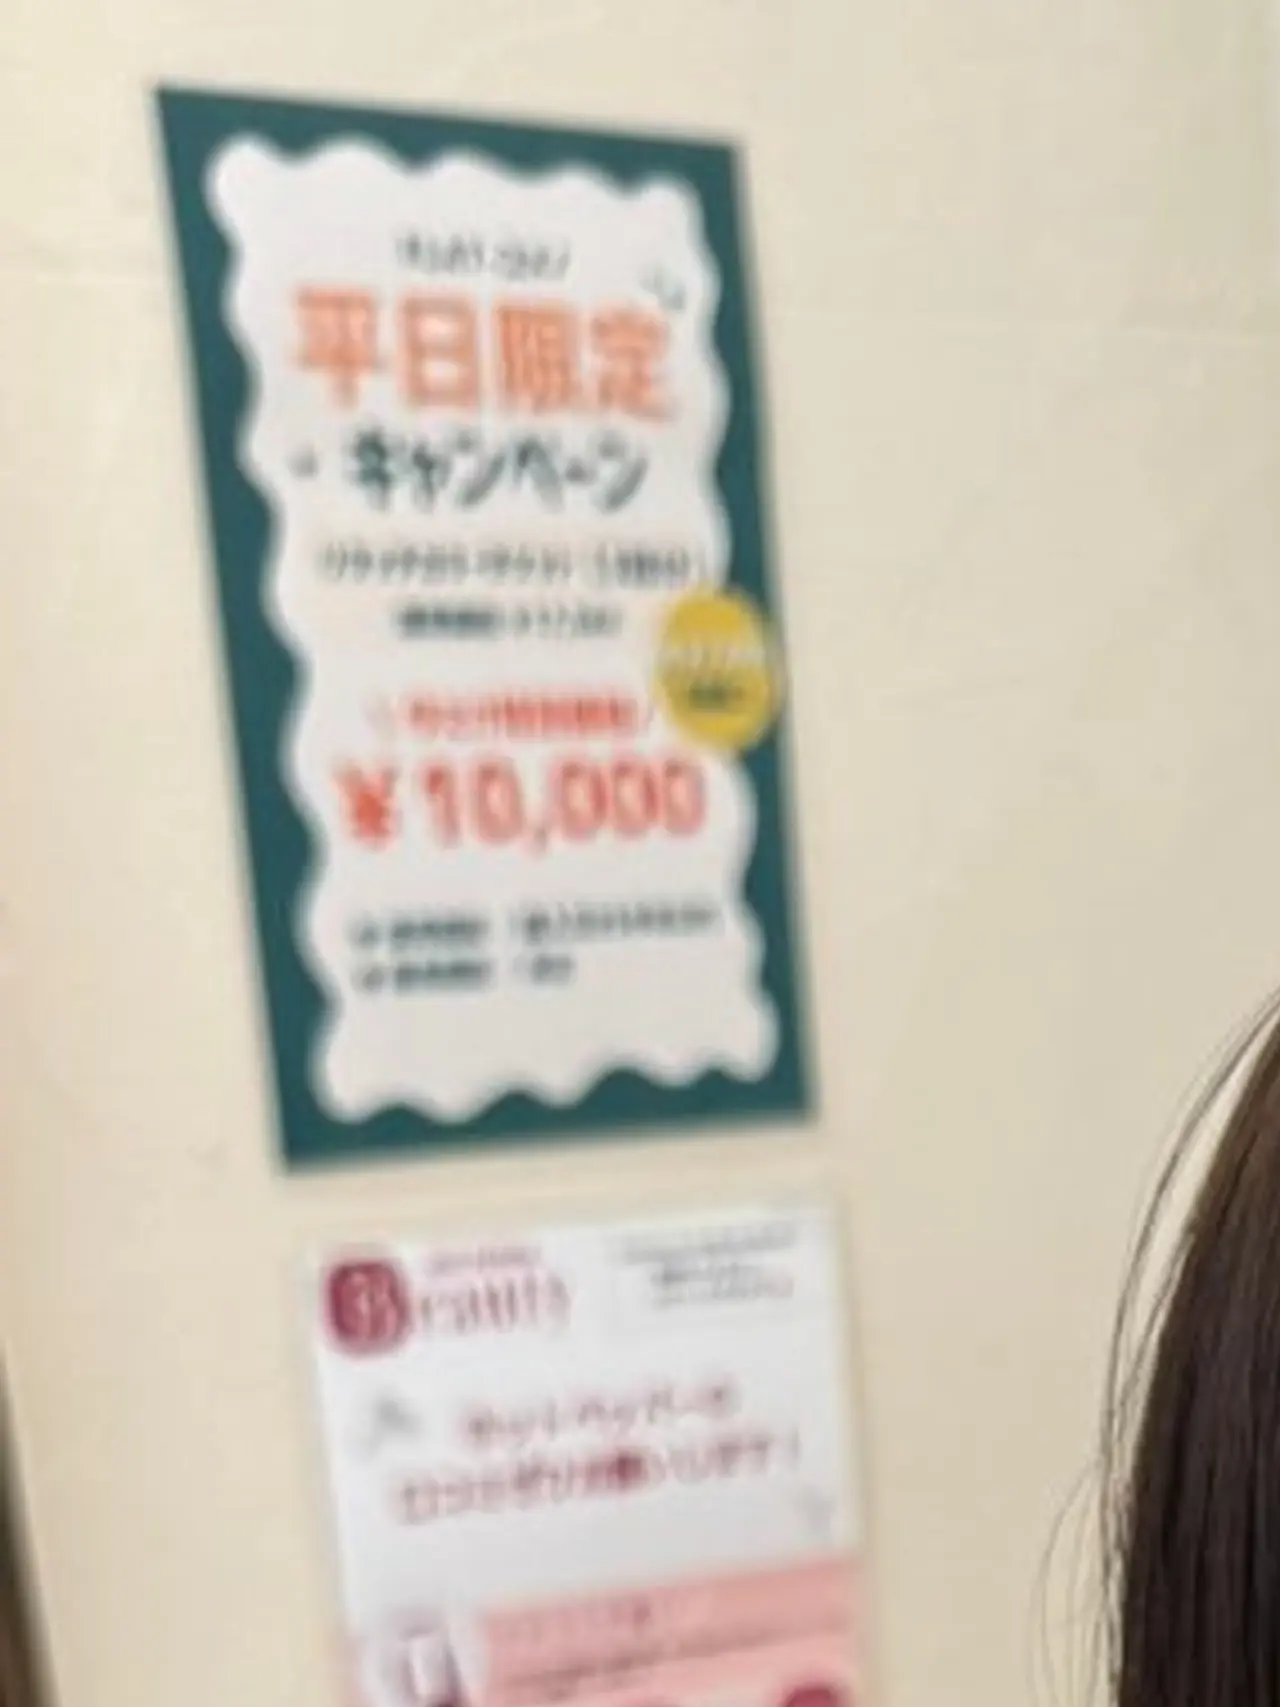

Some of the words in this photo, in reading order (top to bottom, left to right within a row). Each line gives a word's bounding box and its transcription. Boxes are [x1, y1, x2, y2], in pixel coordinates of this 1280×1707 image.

[291, 286, 676, 424] 平日限定
[350, 426, 650, 511] キャンペーン
[335, 752, 709, 854] ¥10,000
